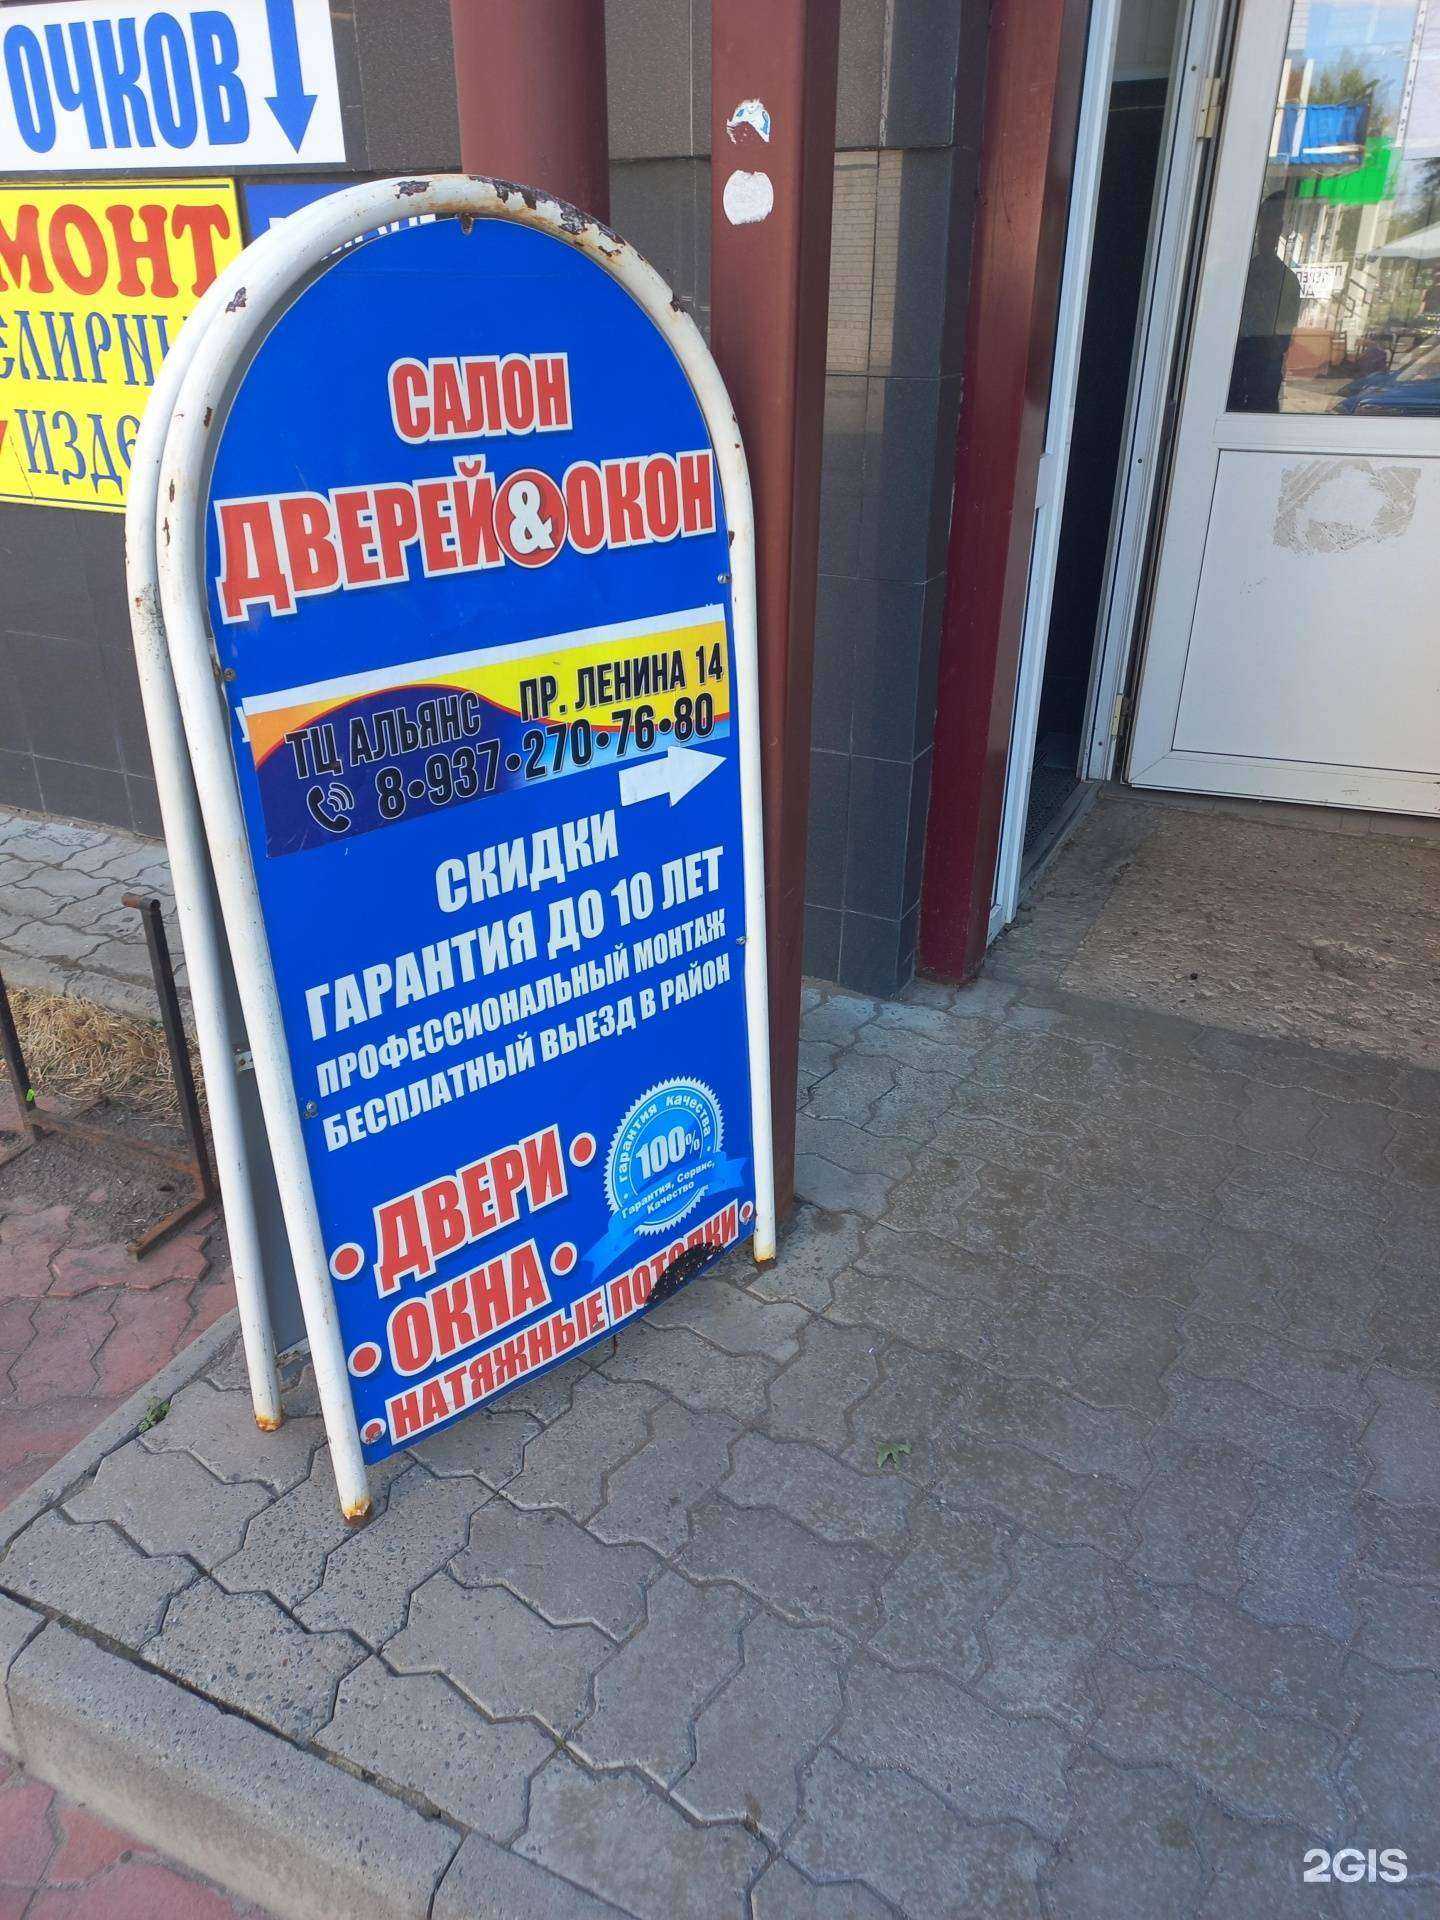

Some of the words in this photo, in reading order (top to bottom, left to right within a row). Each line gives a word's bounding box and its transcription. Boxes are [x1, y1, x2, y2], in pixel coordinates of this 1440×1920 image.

[3, 10, 250, 153] ОЧКОВ
[388, 352, 572, 444] САЛОН
[214, 454, 505, 624] ДВЕРЕЙ
[562, 448, 717, 555] ОКОН
[284, 722, 343, 779] ТЦ
[350, 690, 481, 767] АЛЬЯНС
[519, 675, 568, 723] ПР.
[574, 649, 687, 711] ЛЕНИНА
[695, 642, 724, 686] 14
[435, 809, 619, 913] СКИДКИ
[304, 910, 537, 1042] ГАРАНТИЯ
[547, 889, 605, 960] ДО
[611, 871, 654, 926] 10
[661, 845, 724, 911] ЛЕТ
[315, 944, 630, 1098] ПРОФЕССИОНАЛЬНЫЙ
[633, 908, 727, 975] МОНТАЖ
[322, 1031, 536, 1153] БЕСПЛАТНЫЙ
[539, 1002, 637, 1064] ВЫЕЗД
[640, 988, 656, 1023] В
[660, 953, 731, 1012] РАЙОН
[373, 1123, 569, 1299] ДВЕРИ
[635, 1125, 701, 1180] 100%
[385, 1289, 609, 1446] НАТЯЖНЫЕ
[386, 1238, 552, 1377] ОКНА
